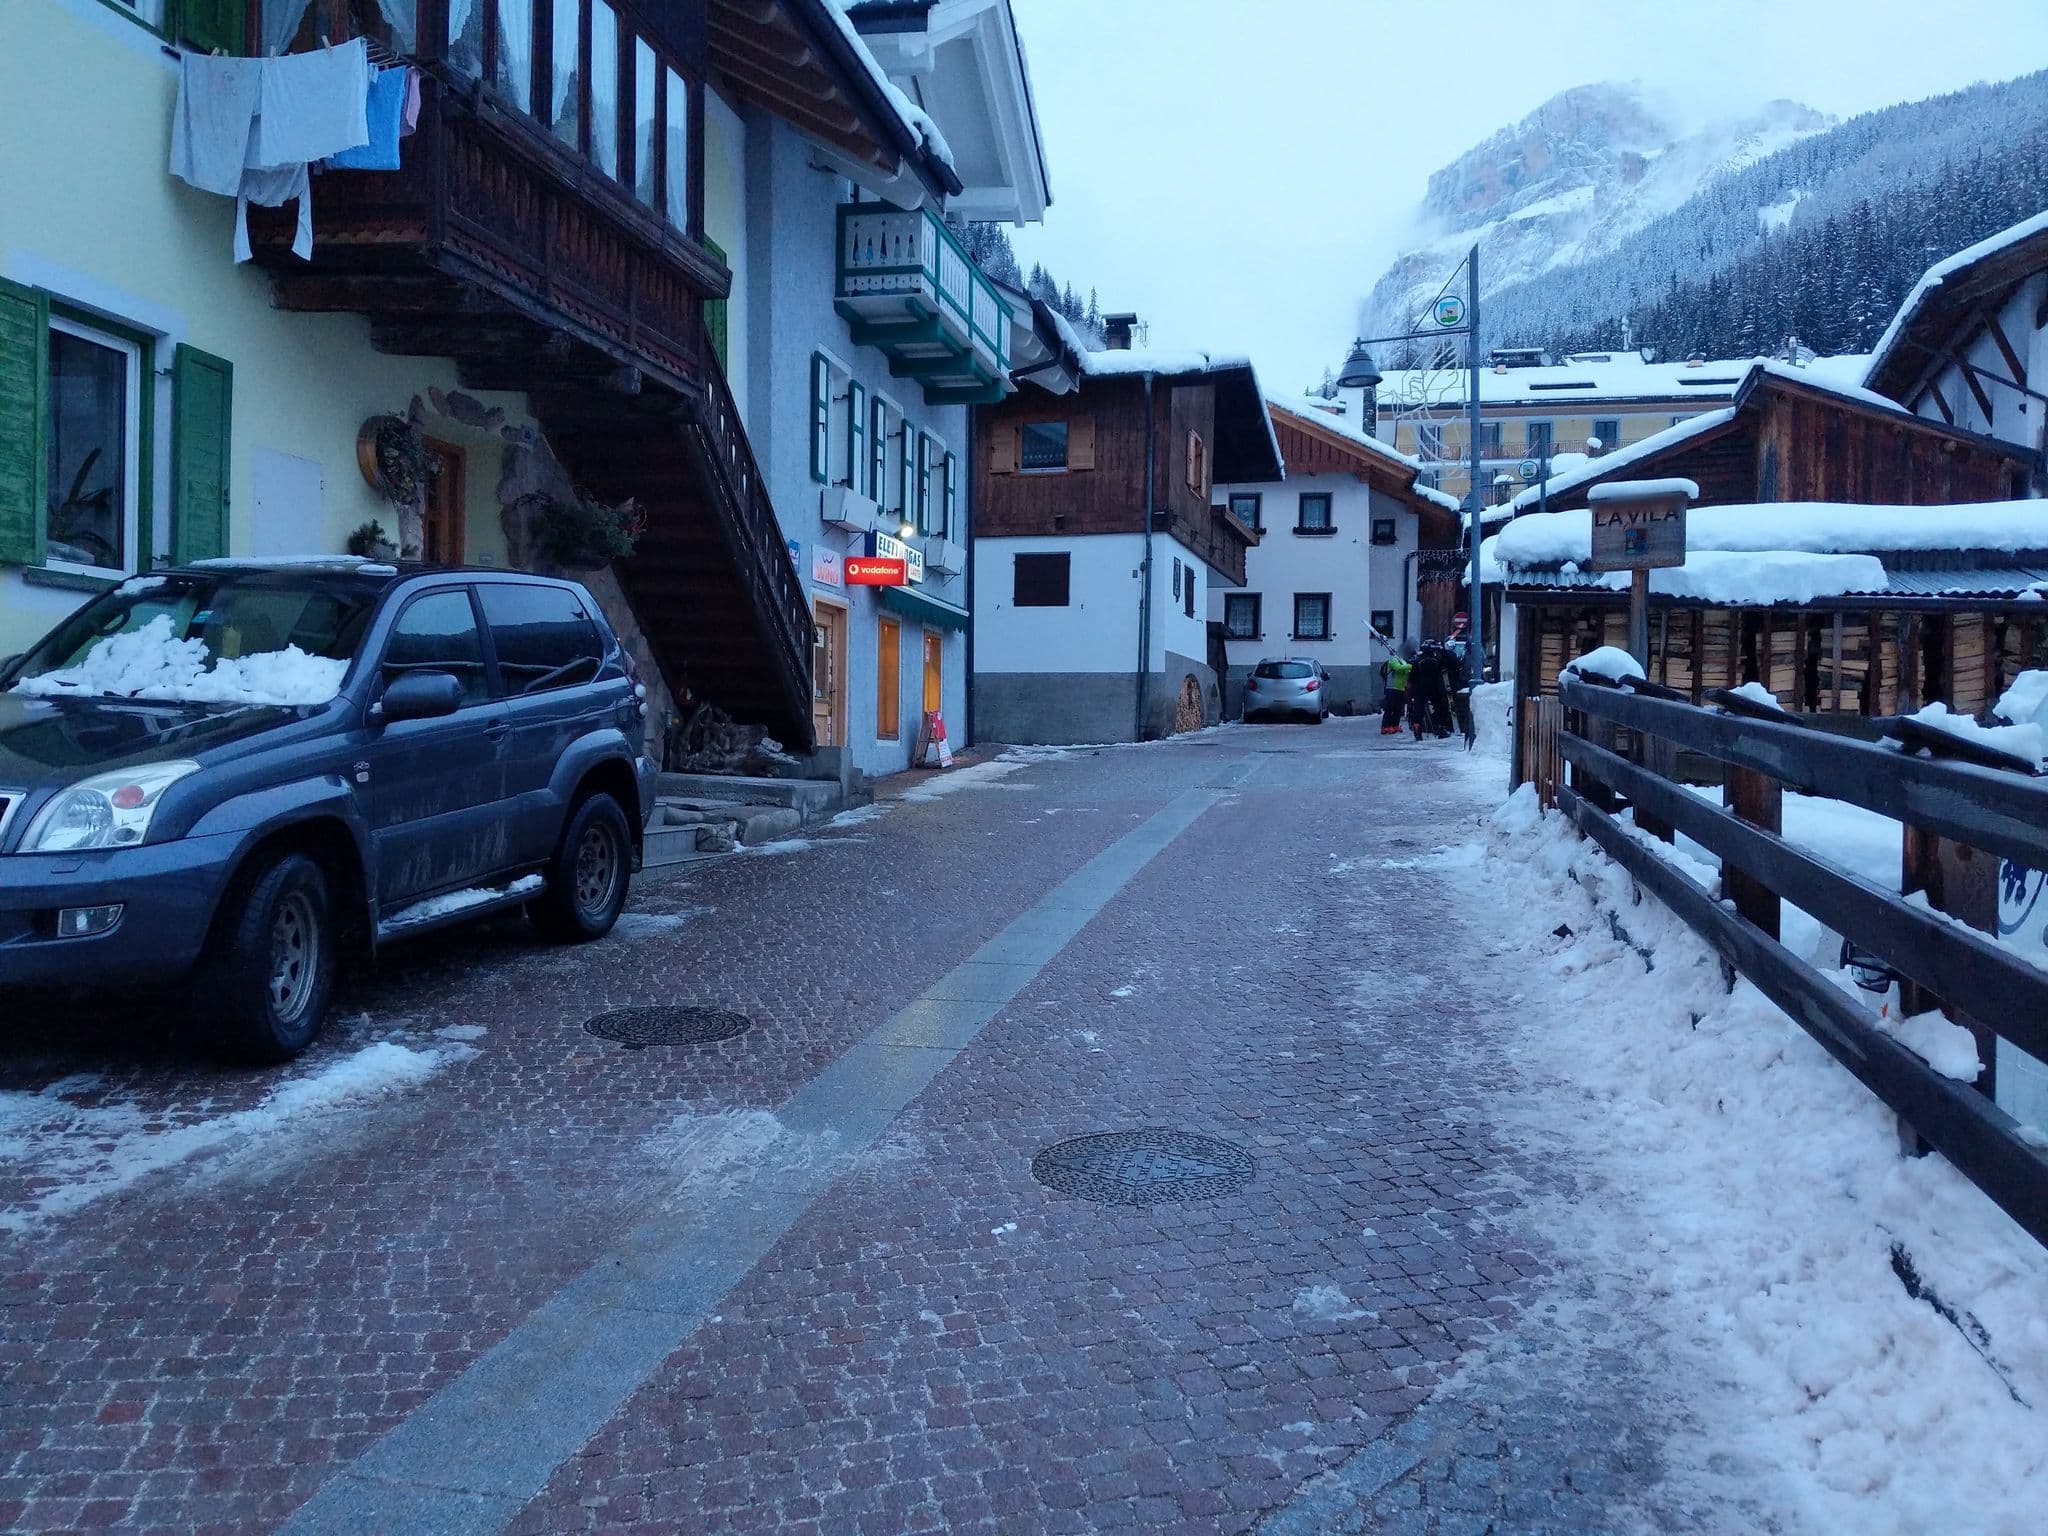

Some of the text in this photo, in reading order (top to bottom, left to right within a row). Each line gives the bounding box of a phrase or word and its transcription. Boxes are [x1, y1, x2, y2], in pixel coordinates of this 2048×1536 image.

[1594, 508, 1680, 528] LA VILA
[878, 536, 921, 567] ELETTGAS
[860, 566, 899, 575] vodafone
